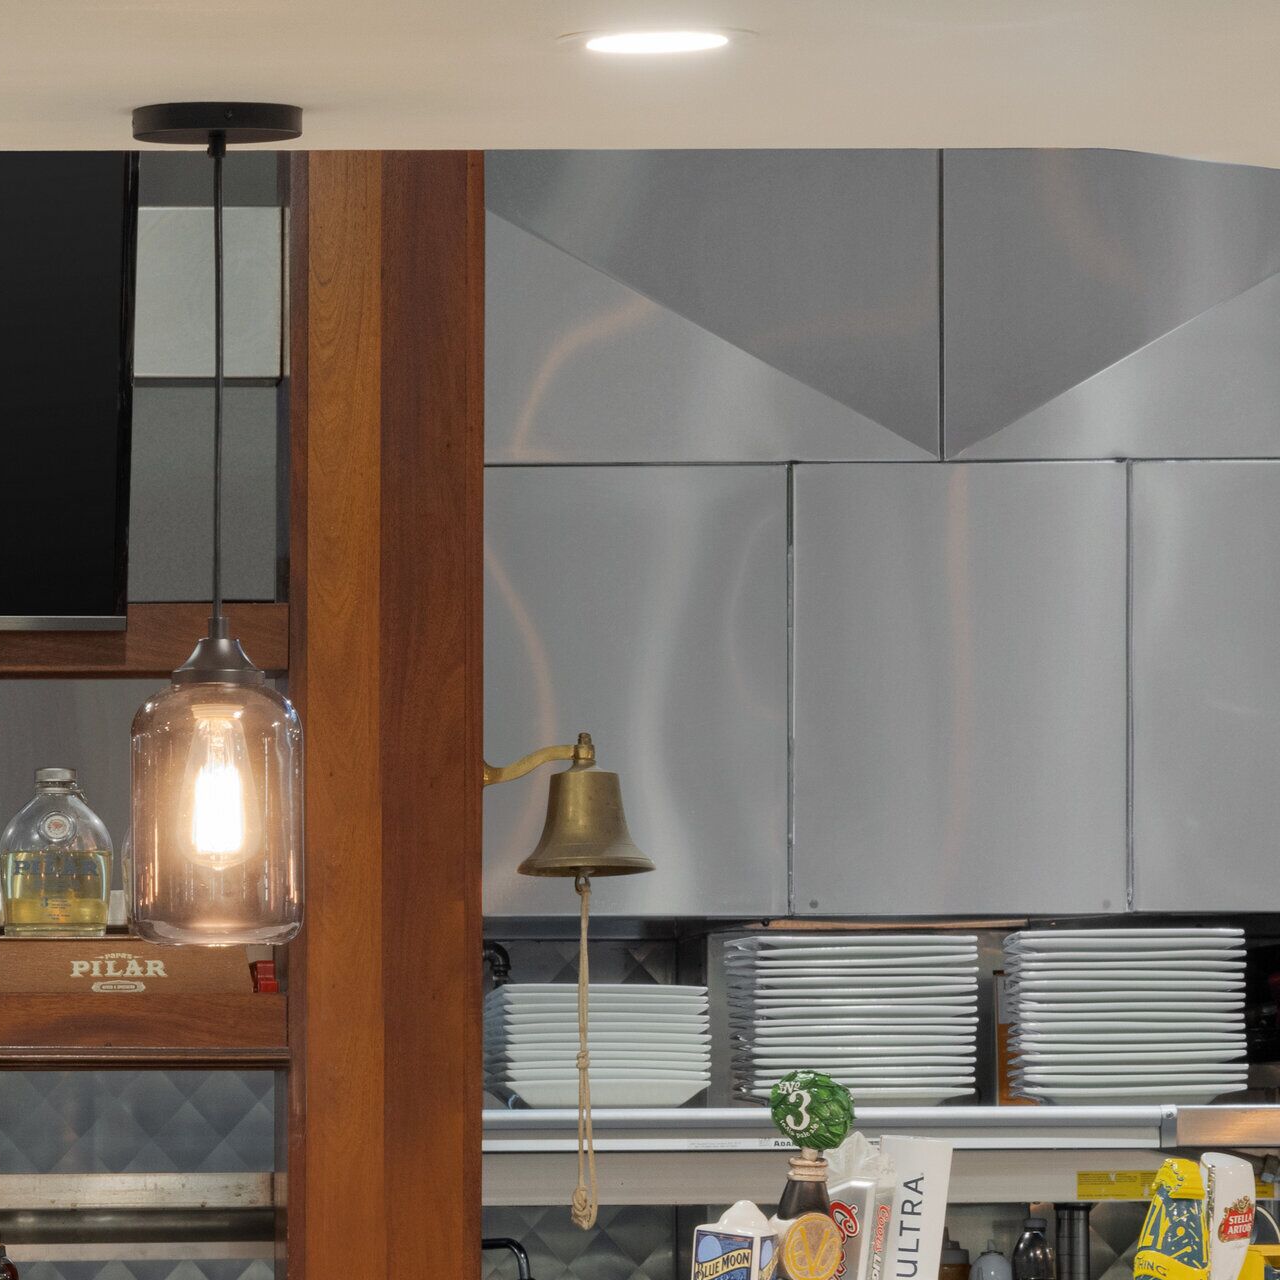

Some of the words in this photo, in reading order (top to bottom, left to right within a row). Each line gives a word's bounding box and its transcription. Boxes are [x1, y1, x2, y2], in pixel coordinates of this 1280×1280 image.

[70, 960, 168, 978] PILAR
[786, 1090, 811, 1130] 3
[874, 1205, 890, 1253] Coors
[896, 1173, 924, 1278] ULTRA
[1228, 1214, 1253, 1225] STELLA
[720, 1252, 751, 1272] MOON
